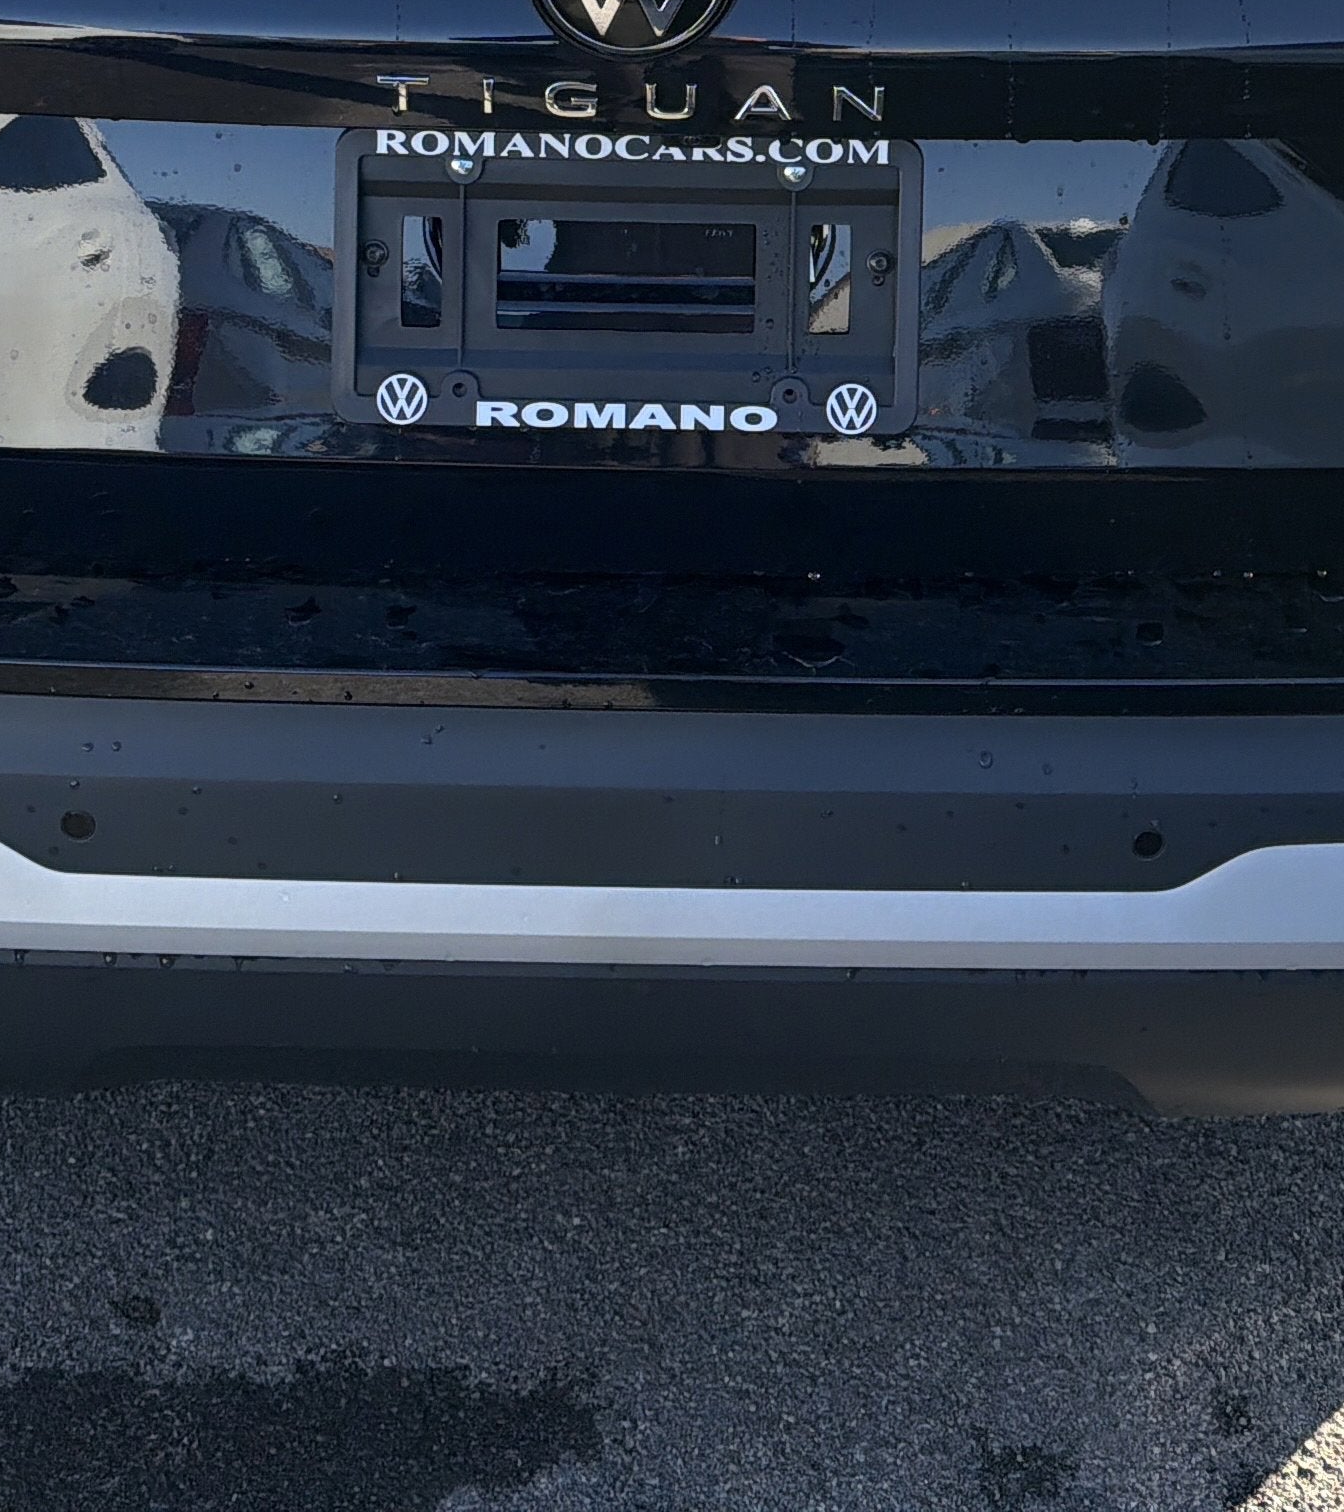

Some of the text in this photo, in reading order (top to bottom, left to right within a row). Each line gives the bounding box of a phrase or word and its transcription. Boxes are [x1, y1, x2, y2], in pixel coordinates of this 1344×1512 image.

[376, 74, 886, 122] TIGUAN
[375, 130, 890, 165] ROMANOCARS.COM
[476, 400, 778, 432] ROMANO
